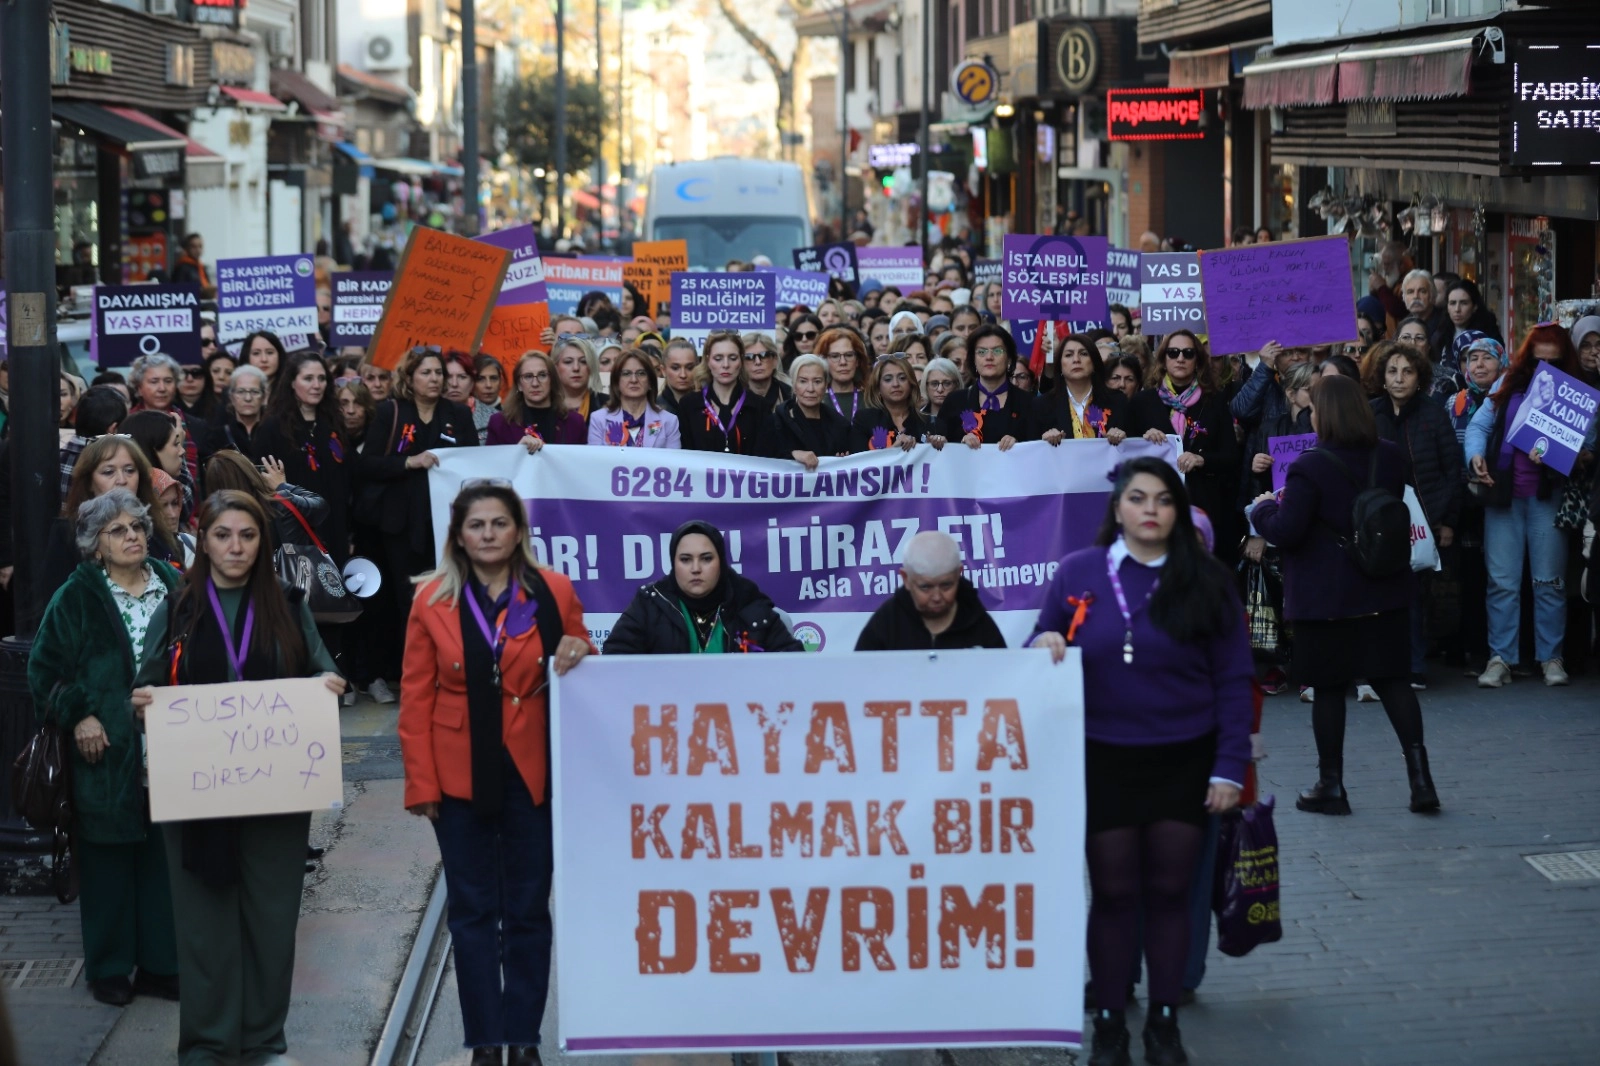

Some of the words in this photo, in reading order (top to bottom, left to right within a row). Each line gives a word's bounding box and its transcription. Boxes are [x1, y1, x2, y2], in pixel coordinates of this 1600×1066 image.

[1068, 36, 1086, 79] B
[1521, 76, 1600, 101] FABRİK
[1111, 100, 1199, 126] PAŞABAHÇE
[1008, 251, 1088, 268] İSTANBUL
[220, 268, 235, 279] 25
[543, 262, 589, 280] İKTİDAR
[592, 266, 622, 282] ELİNİ
[974, 263, 1002, 275] HAYA
[1007, 269, 1104, 287] SÖZLEŞMESİ
[1146, 263, 1182, 277] YAS
[221, 277, 293, 294] BİRLİĞİMİZ
[337, 278, 359, 292] BİR
[681, 279, 696, 289] 25
[701, 279, 765, 289] KASIM'DA
[783, 275, 827, 293] ÖZGÜR
[1162, 286, 1203, 300] YAŞ
[99, 292, 198, 309] DAYANIŞMA
[222, 296, 241, 308] BU
[244, 291, 295, 307] DÜZENİ
[681, 292, 765, 306] BİRLİĞİMİZ
[780, 291, 825, 305] KADIN
[1007, 289, 1088, 306] YAŞATIR!
[107, 311, 190, 330] YAŞATIR!
[343, 305, 382, 319] HEPİM
[681, 312, 701, 323] BU
[707, 309, 765, 324] DÜZENİ
[1147, 306, 1205, 321] İSTİYO
[225, 315, 312, 332] SARSACAK!
[336, 323, 376, 335] GÖLGE
[1557, 381, 1597, 414] ÖZGÜR
[1549, 400, 1590, 432] KADIN
[1529, 412, 1548, 428] EŞİT
[1547, 422, 1580, 448] TOPLUM!
[610, 465, 694, 498] 6284
[706, 463, 914, 499] UYGULANSIN
[529, 526, 599, 582] ÖR!
[767, 515, 920, 574] İTİRAZ
[937, 513, 1006, 562] ET!
[798, 572, 853, 601] Asla
[166, 691, 294, 725] SUSMA
[223, 723, 299, 755] YÜRÜ
[630, 698, 1029, 777] HAYATTA
[191, 764, 273, 791] DİREN
[630, 799, 910, 860] KALMAK
[932, 782, 1036, 855] BİR
[635, 863, 1035, 975] DEVRİM!
